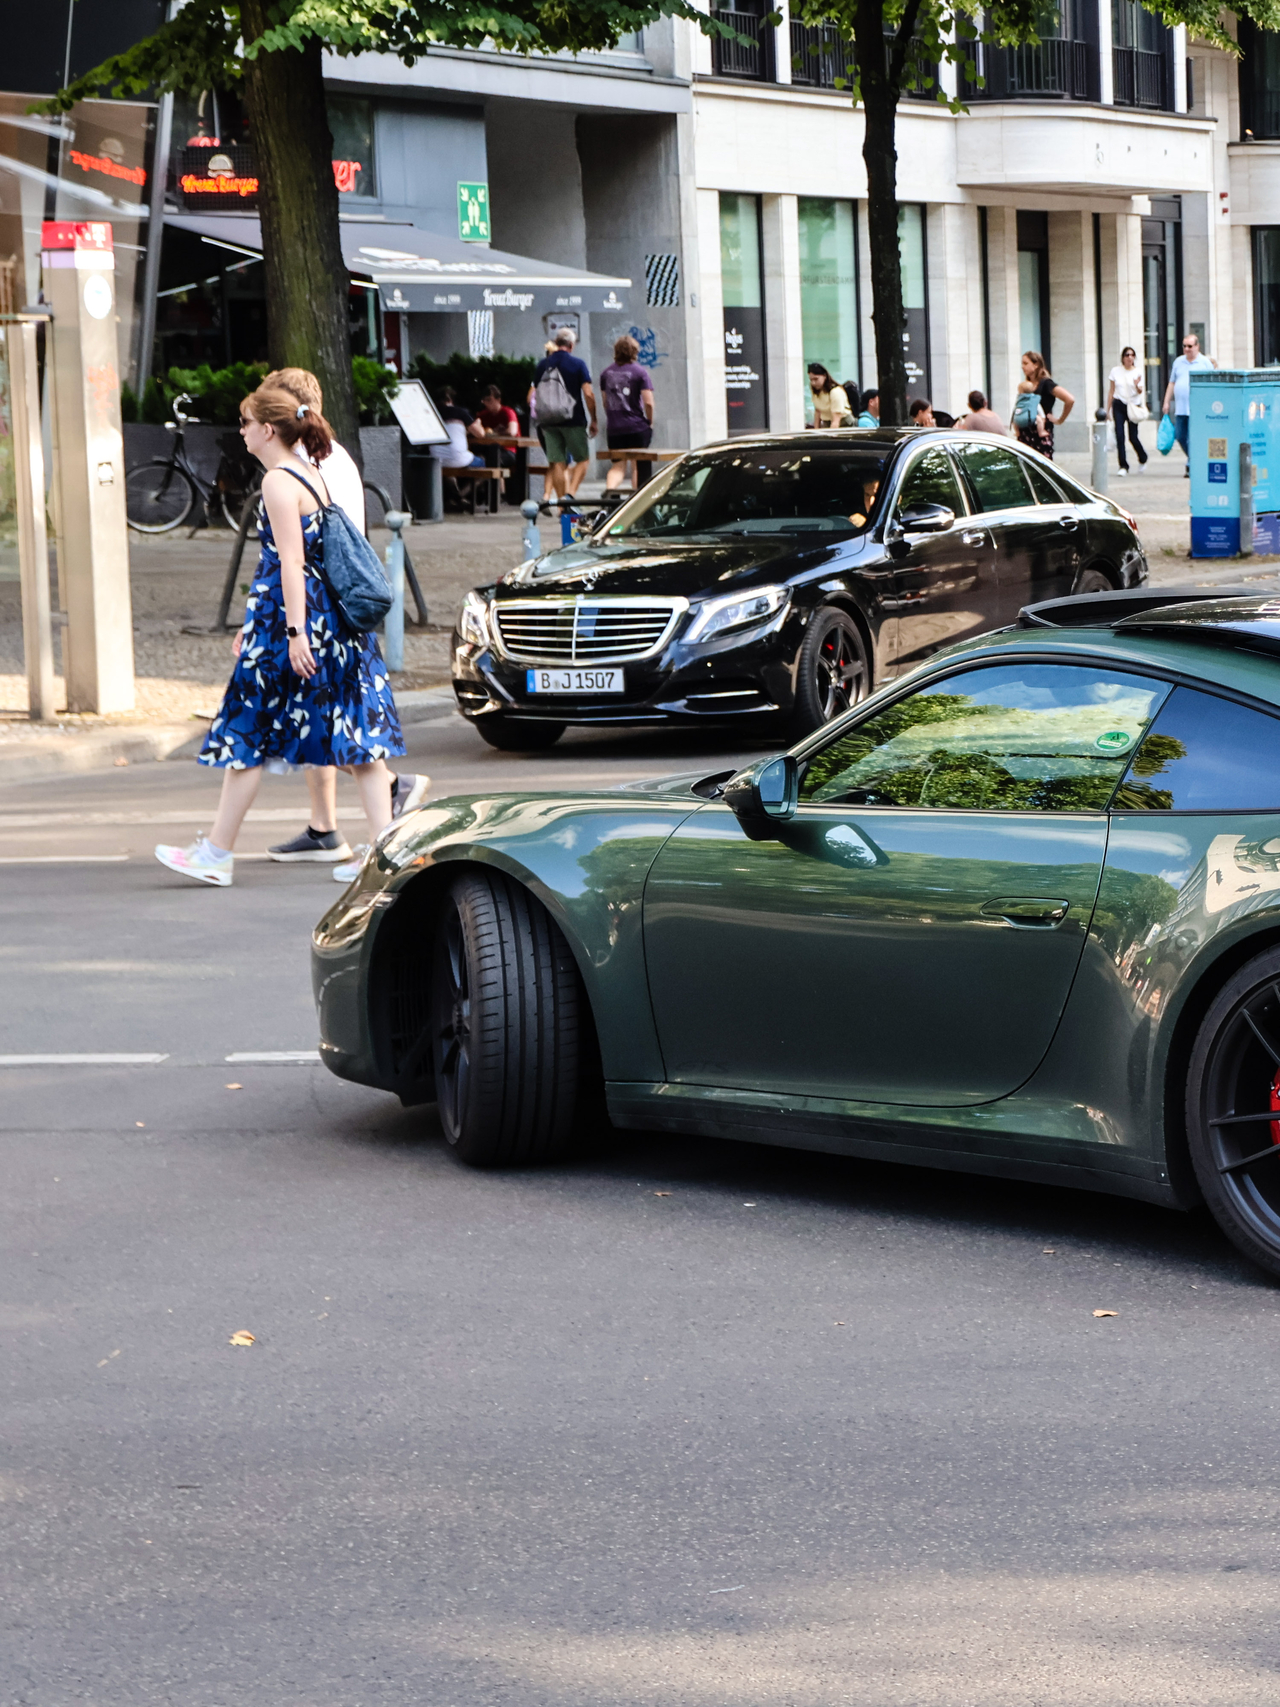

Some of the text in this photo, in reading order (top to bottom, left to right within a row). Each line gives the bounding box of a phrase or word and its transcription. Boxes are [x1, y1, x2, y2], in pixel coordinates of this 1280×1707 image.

[541, 672, 615, 689] B J 1507
